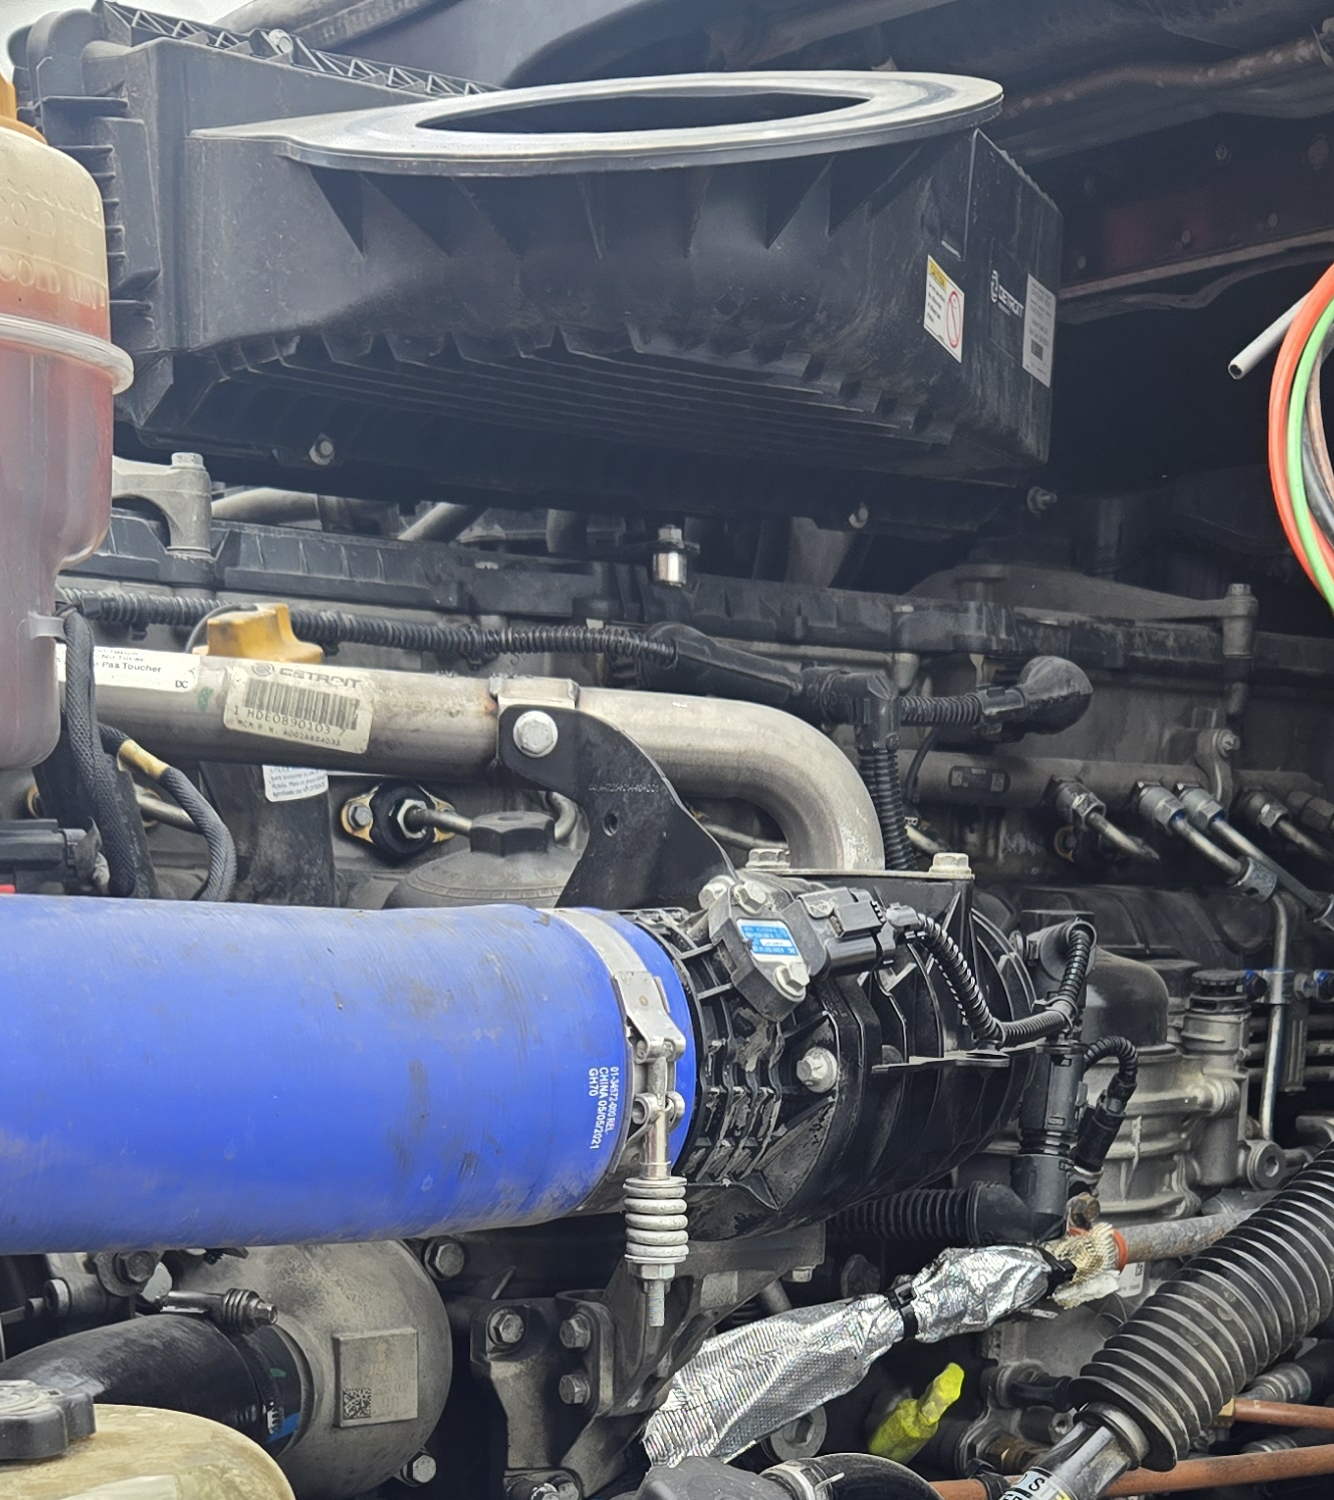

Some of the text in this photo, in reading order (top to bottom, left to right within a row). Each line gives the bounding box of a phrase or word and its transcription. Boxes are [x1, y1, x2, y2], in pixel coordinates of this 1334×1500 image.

[122, 662, 162, 673] Toucher
[175, 680, 189, 689] DC
[588, 1068, 598, 1096] GH70
[599, 1067, 608, 1098] CHINA
